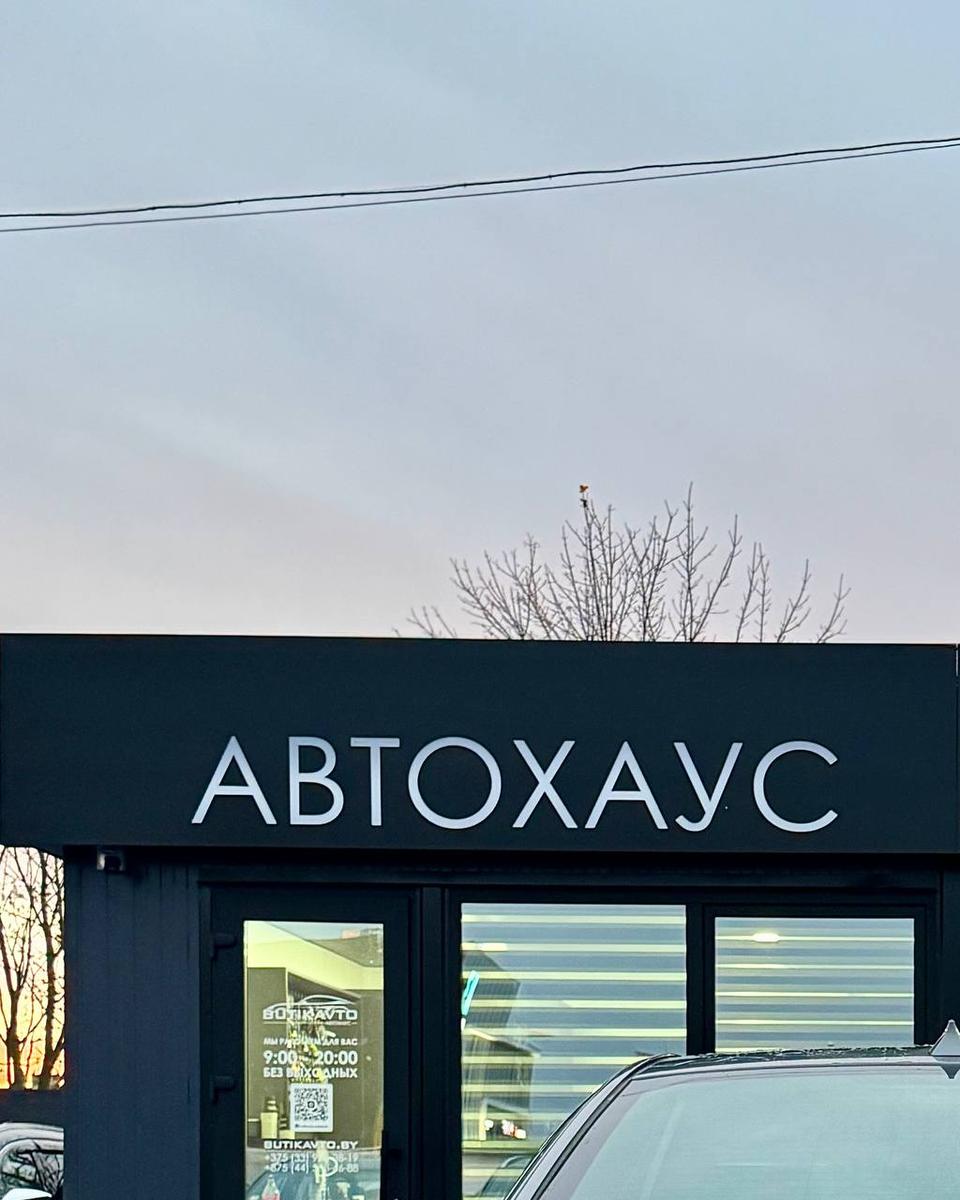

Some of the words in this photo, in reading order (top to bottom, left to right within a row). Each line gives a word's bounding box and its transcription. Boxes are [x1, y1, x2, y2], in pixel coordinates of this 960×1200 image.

[191, 735, 838, 832] АВТОХАУС
[262, 1008, 358, 1020] BUTIKAVTO
[263, 1050, 298, 1065] 9:00
[314, 1050, 358, 1065] 20:00
[263, 1067, 283, 1078] БЕЗ
